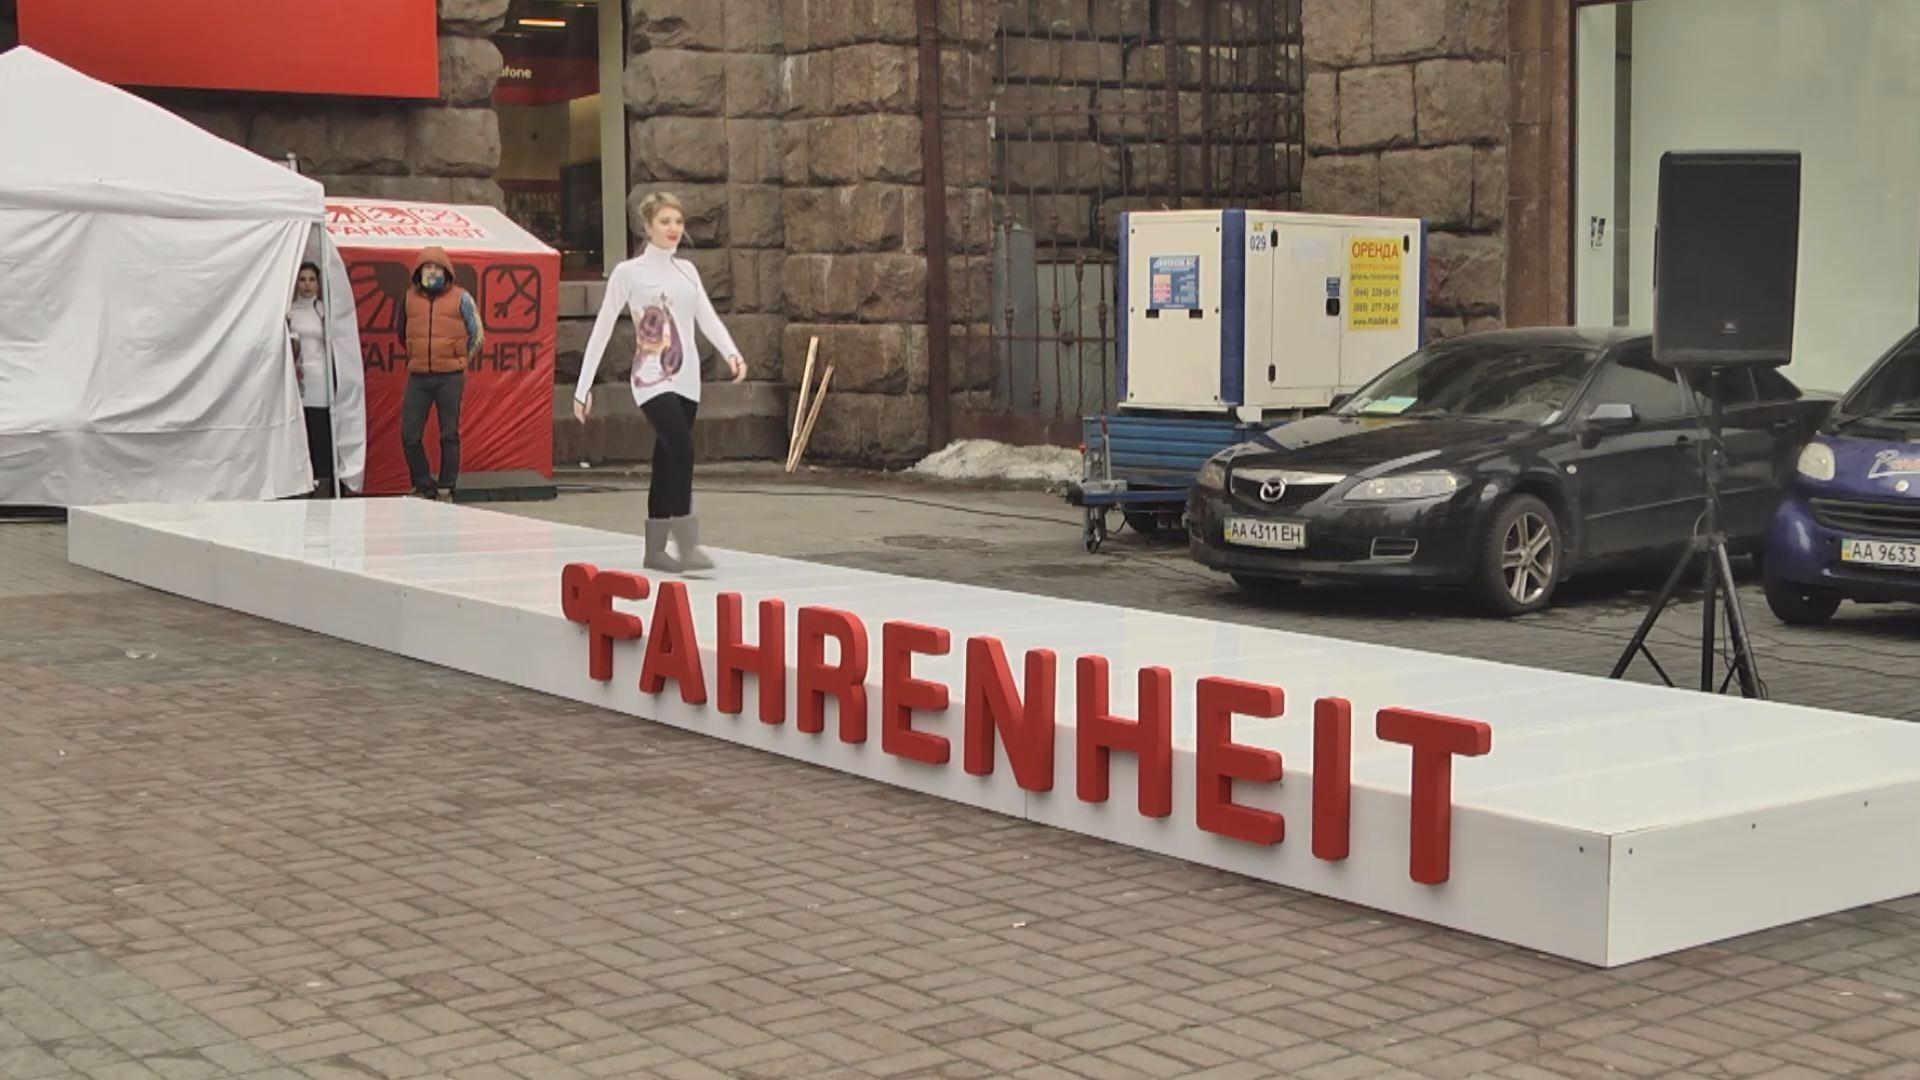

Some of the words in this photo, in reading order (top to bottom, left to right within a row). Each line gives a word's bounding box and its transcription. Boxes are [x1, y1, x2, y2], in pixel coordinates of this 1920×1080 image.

[1250, 234, 1267, 252] 029
[1351, 241, 1398, 260] ОРЕНДА
[1231, 522, 1247, 539] AA
[1250, 523, 1278, 541] 4311
[1281, 525, 1301, 543] EH
[1852, 543, 1873, 561] AA
[1879, 545, 1916, 563] 9633
